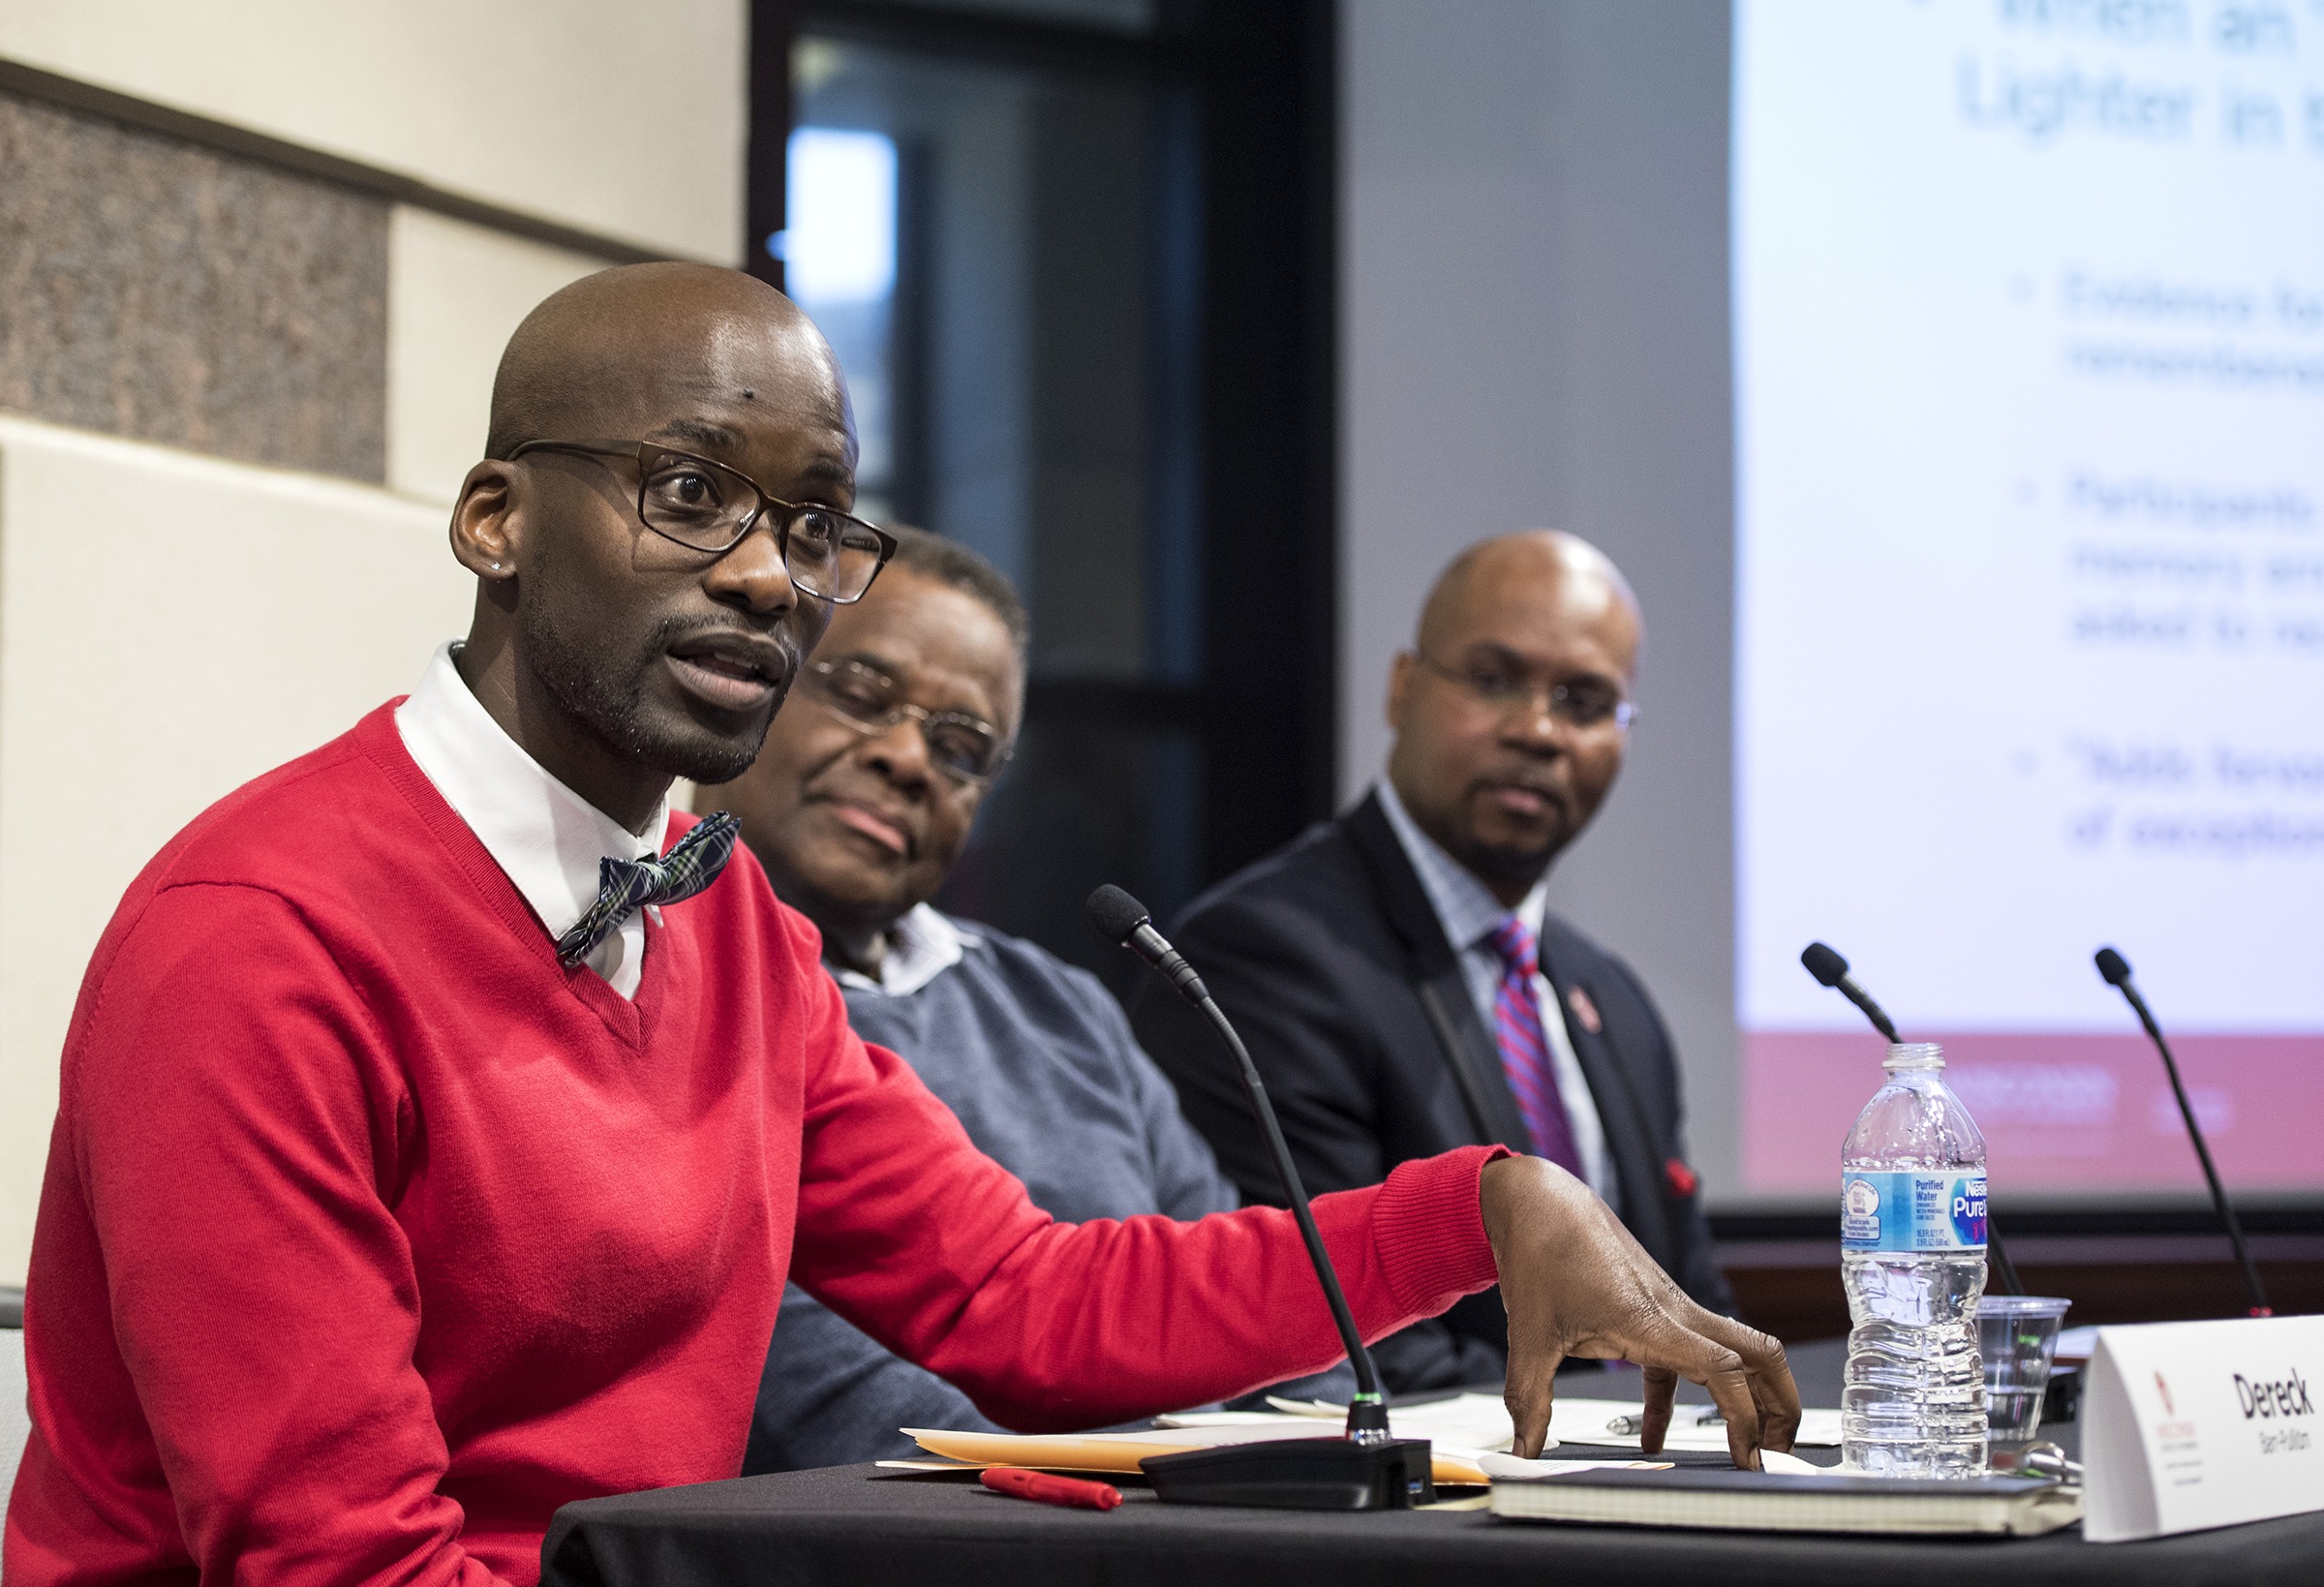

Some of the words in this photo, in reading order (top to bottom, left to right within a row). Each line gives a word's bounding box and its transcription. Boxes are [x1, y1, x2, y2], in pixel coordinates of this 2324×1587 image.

[1956, 46, 2192, 149] Lighter
[2221, 72, 2284, 151] in
[1916, 1180, 1943, 1190] Purified
[1916, 1191, 1938, 1201] Water
[2233, 1367, 2314, 1419] Dereck
